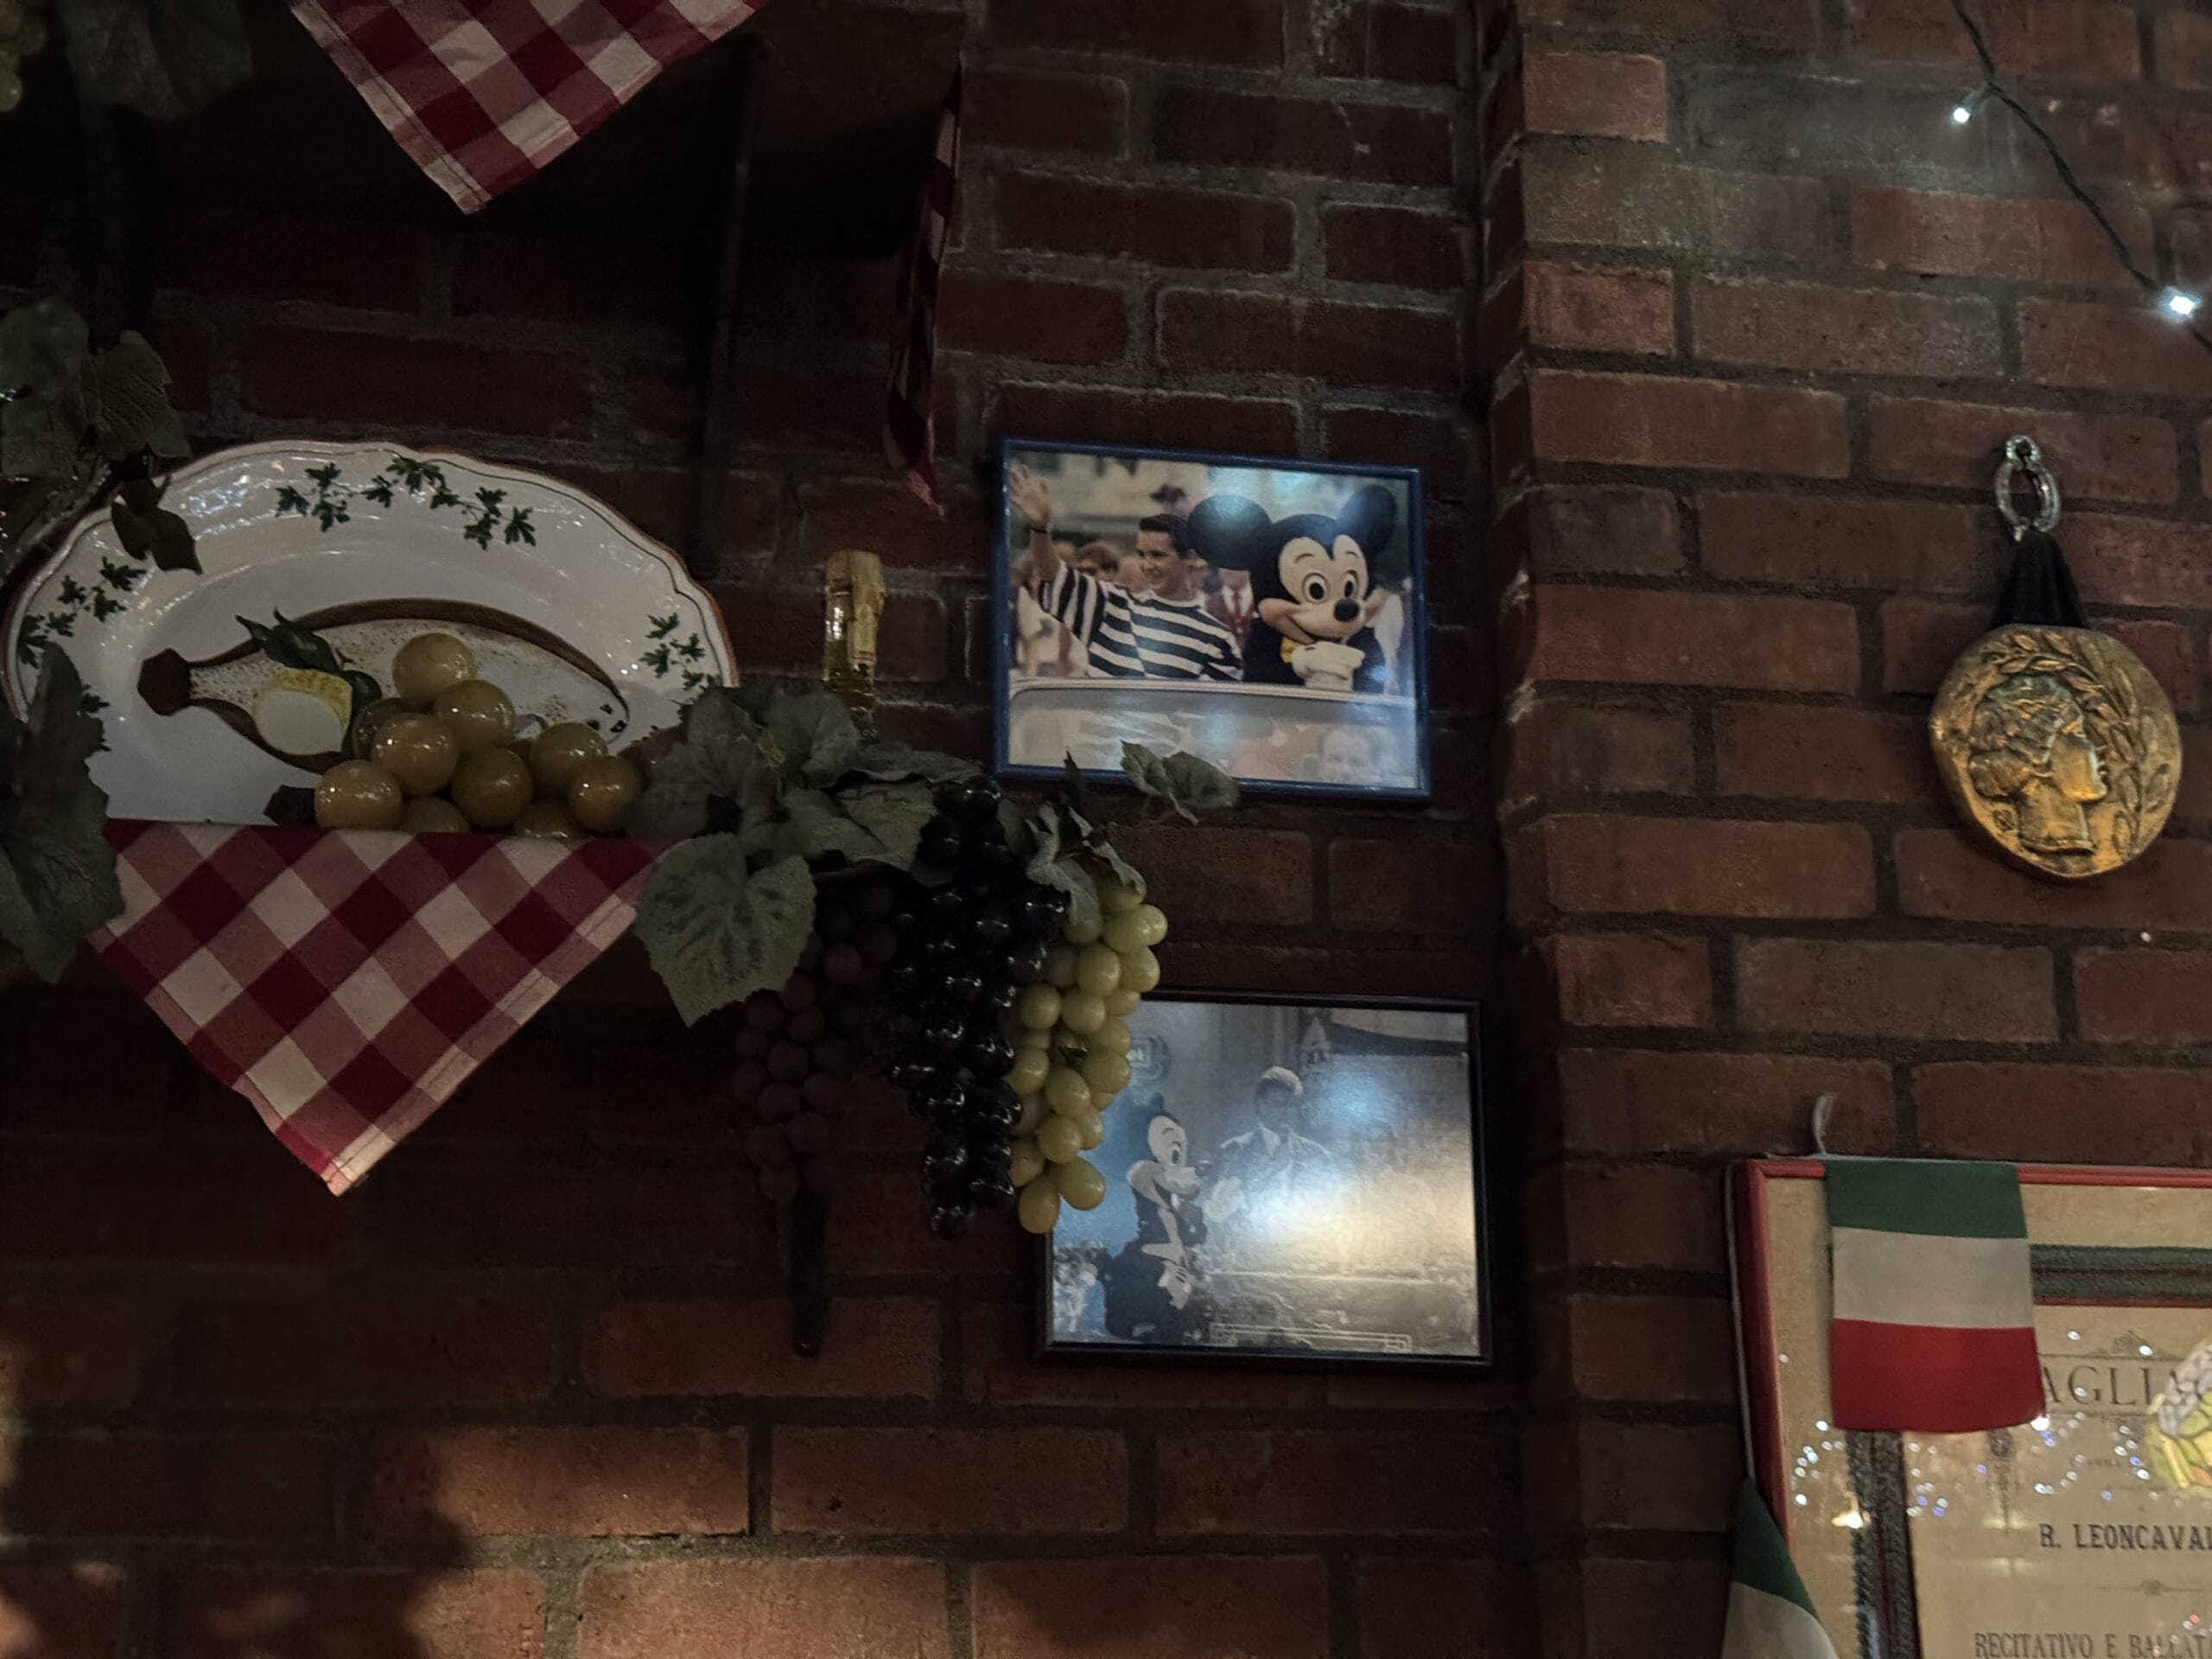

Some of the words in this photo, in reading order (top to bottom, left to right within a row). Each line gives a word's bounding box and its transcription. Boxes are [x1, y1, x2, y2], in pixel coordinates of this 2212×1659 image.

[2043, 1365, 2179, 1406] AGLI
[2039, 1523, 2062, 1548] R.
[1974, 1632, 2094, 1658] RECITATIVO
[2105, 1633, 2117, 1659] E
[2128, 1633, 2212, 1659] BALLAT
